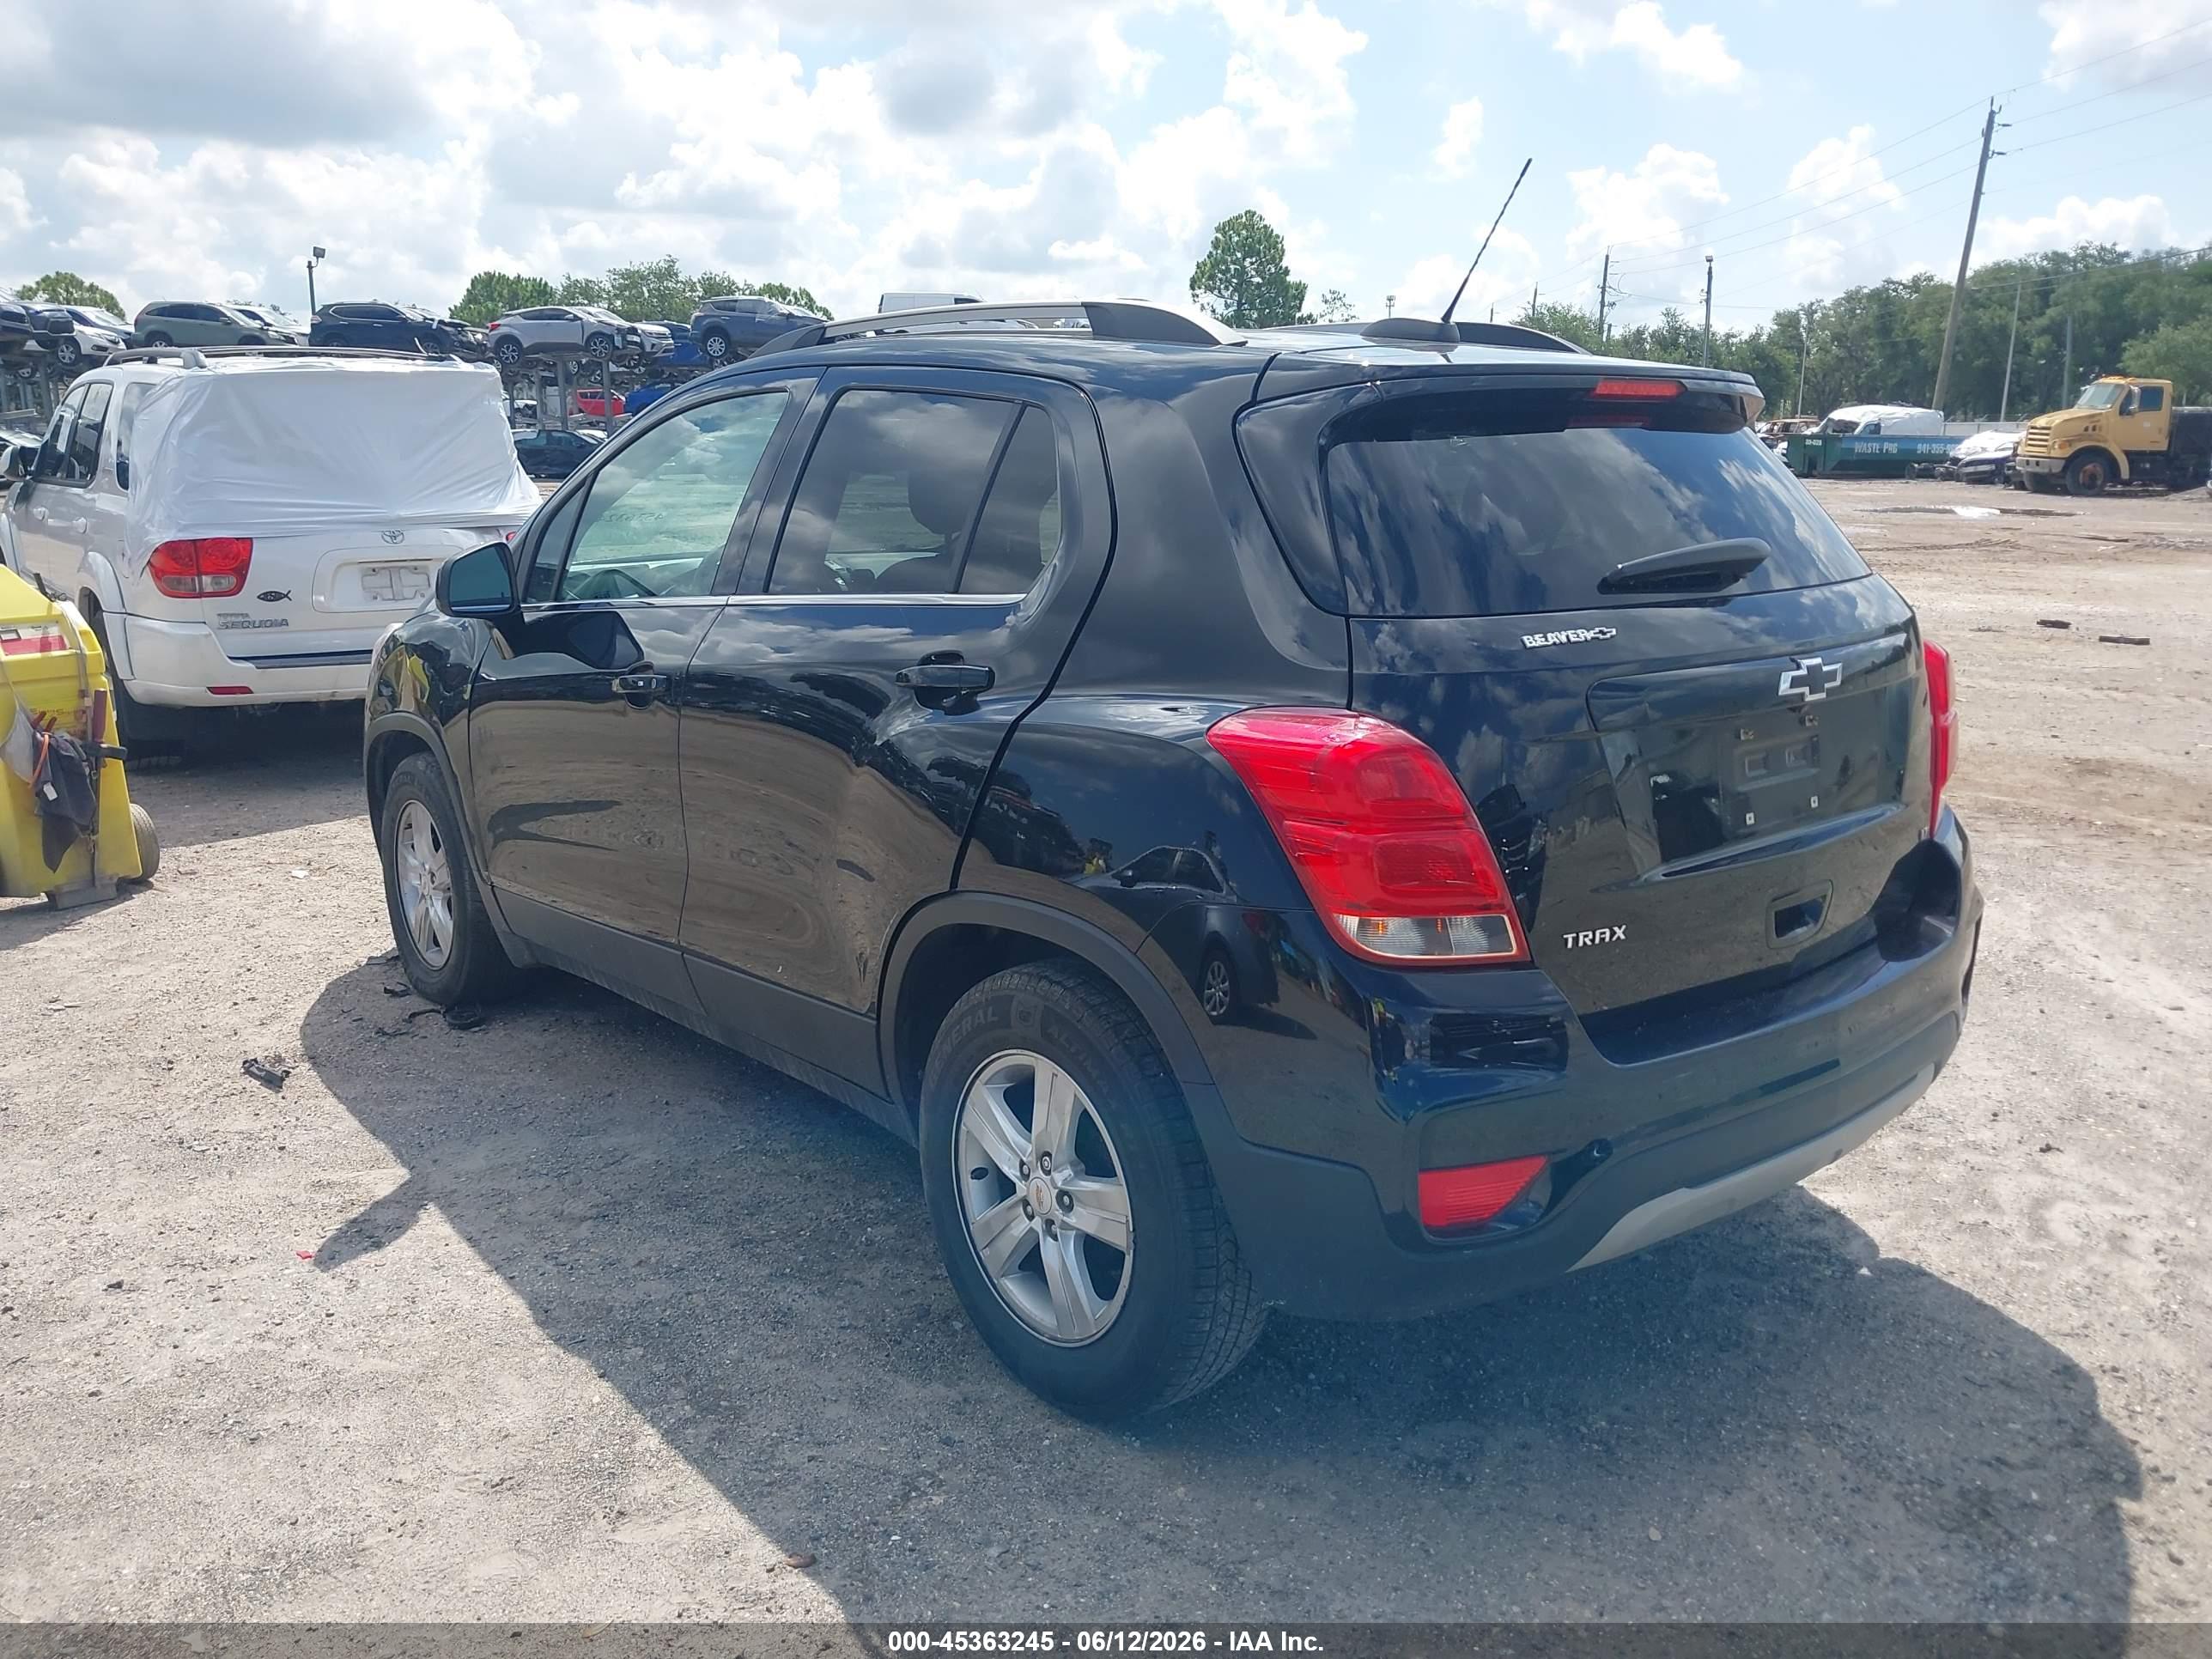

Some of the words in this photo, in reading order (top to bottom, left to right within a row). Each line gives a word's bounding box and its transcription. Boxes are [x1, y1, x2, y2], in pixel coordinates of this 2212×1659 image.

[1855, 441, 1880, 453] WASTE
[218, 617, 289, 629] SEQUOIA
[1521, 628, 1590, 648] BEAVER
[1562, 924, 1627, 949] TRAX
